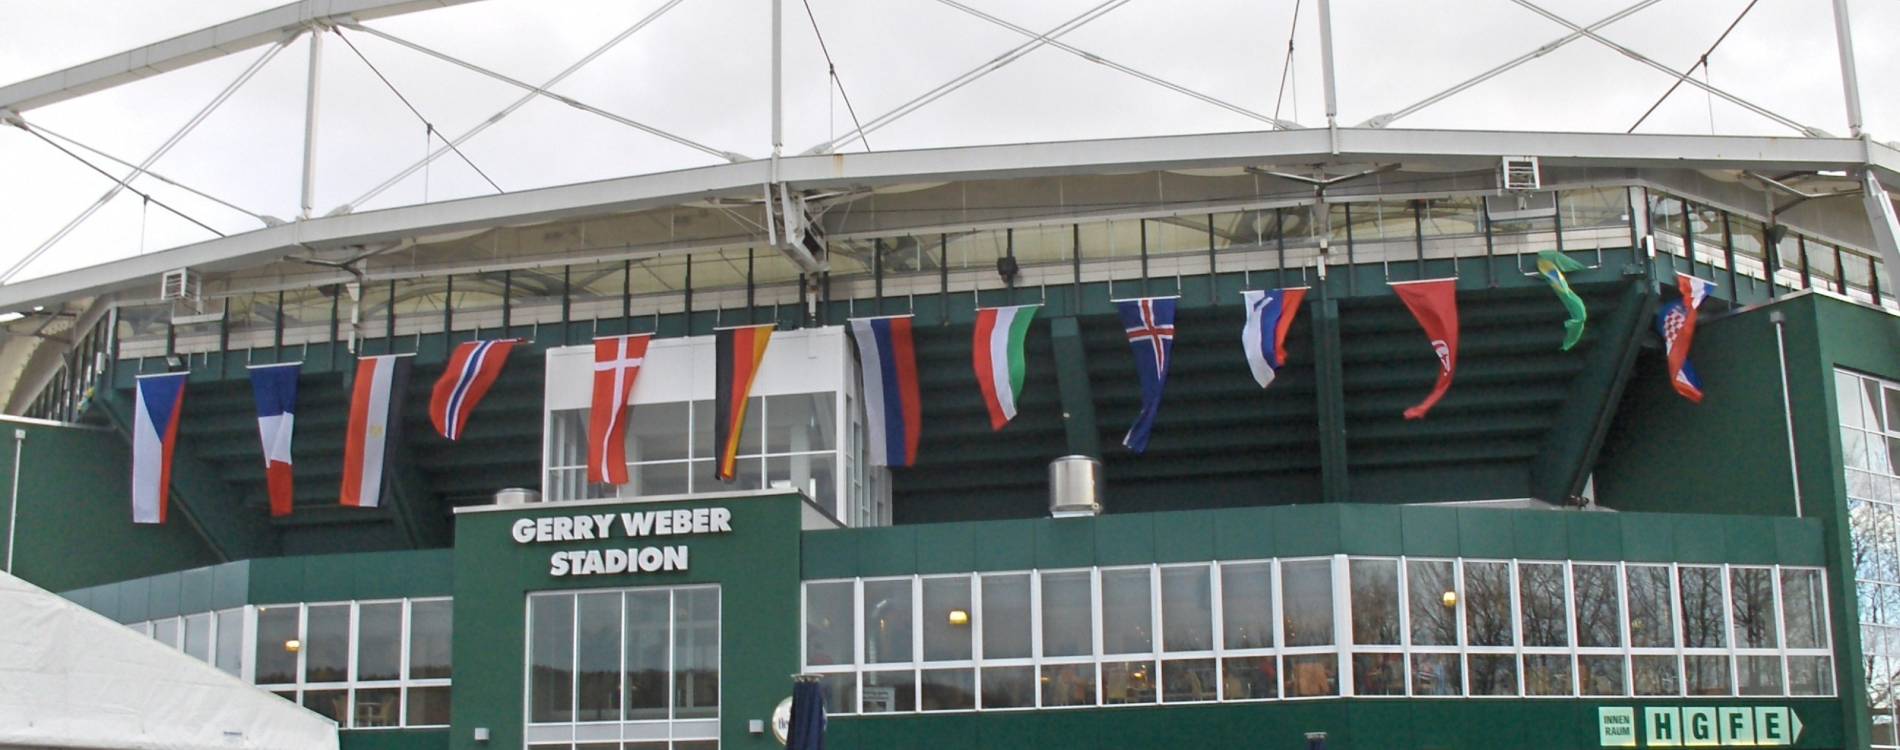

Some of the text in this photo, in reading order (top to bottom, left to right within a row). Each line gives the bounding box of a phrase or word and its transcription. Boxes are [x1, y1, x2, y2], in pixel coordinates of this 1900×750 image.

[512, 507, 732, 543] GERRY WEBER
[550, 545, 688, 576] STADION
[1603, 715, 1630, 724] INNEN
[1604, 726, 1630, 736] RAUM
[1654, 712, 1781, 740] H G F E
